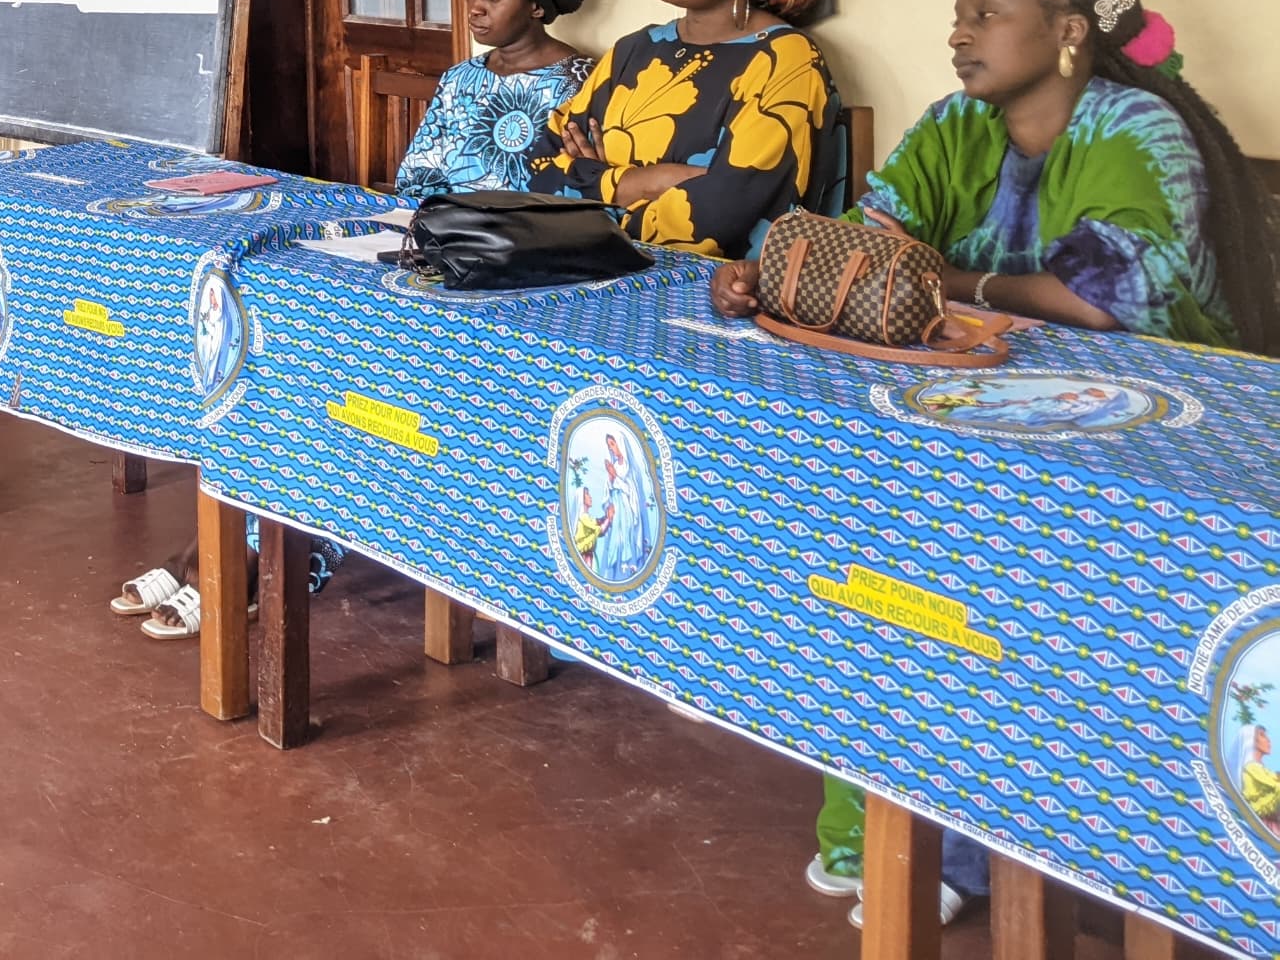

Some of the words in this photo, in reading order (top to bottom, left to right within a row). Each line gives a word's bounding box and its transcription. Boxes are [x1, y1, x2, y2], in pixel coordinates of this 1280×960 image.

[371, 402, 392, 417] POUR
[394, 410, 418, 427] NOUS
[368, 420, 403, 441] RECOURS
[413, 434, 437, 454] VOUS
[851, 567, 887, 594] PRIEZ
[891, 583, 925, 606] POUR
[929, 596, 965, 622] NOUS
[811, 578, 834, 598] QUI
[838, 589, 883, 616] AVONS
[887, 604, 948, 637] RECOURS
[963, 632, 999, 657] VOUS
